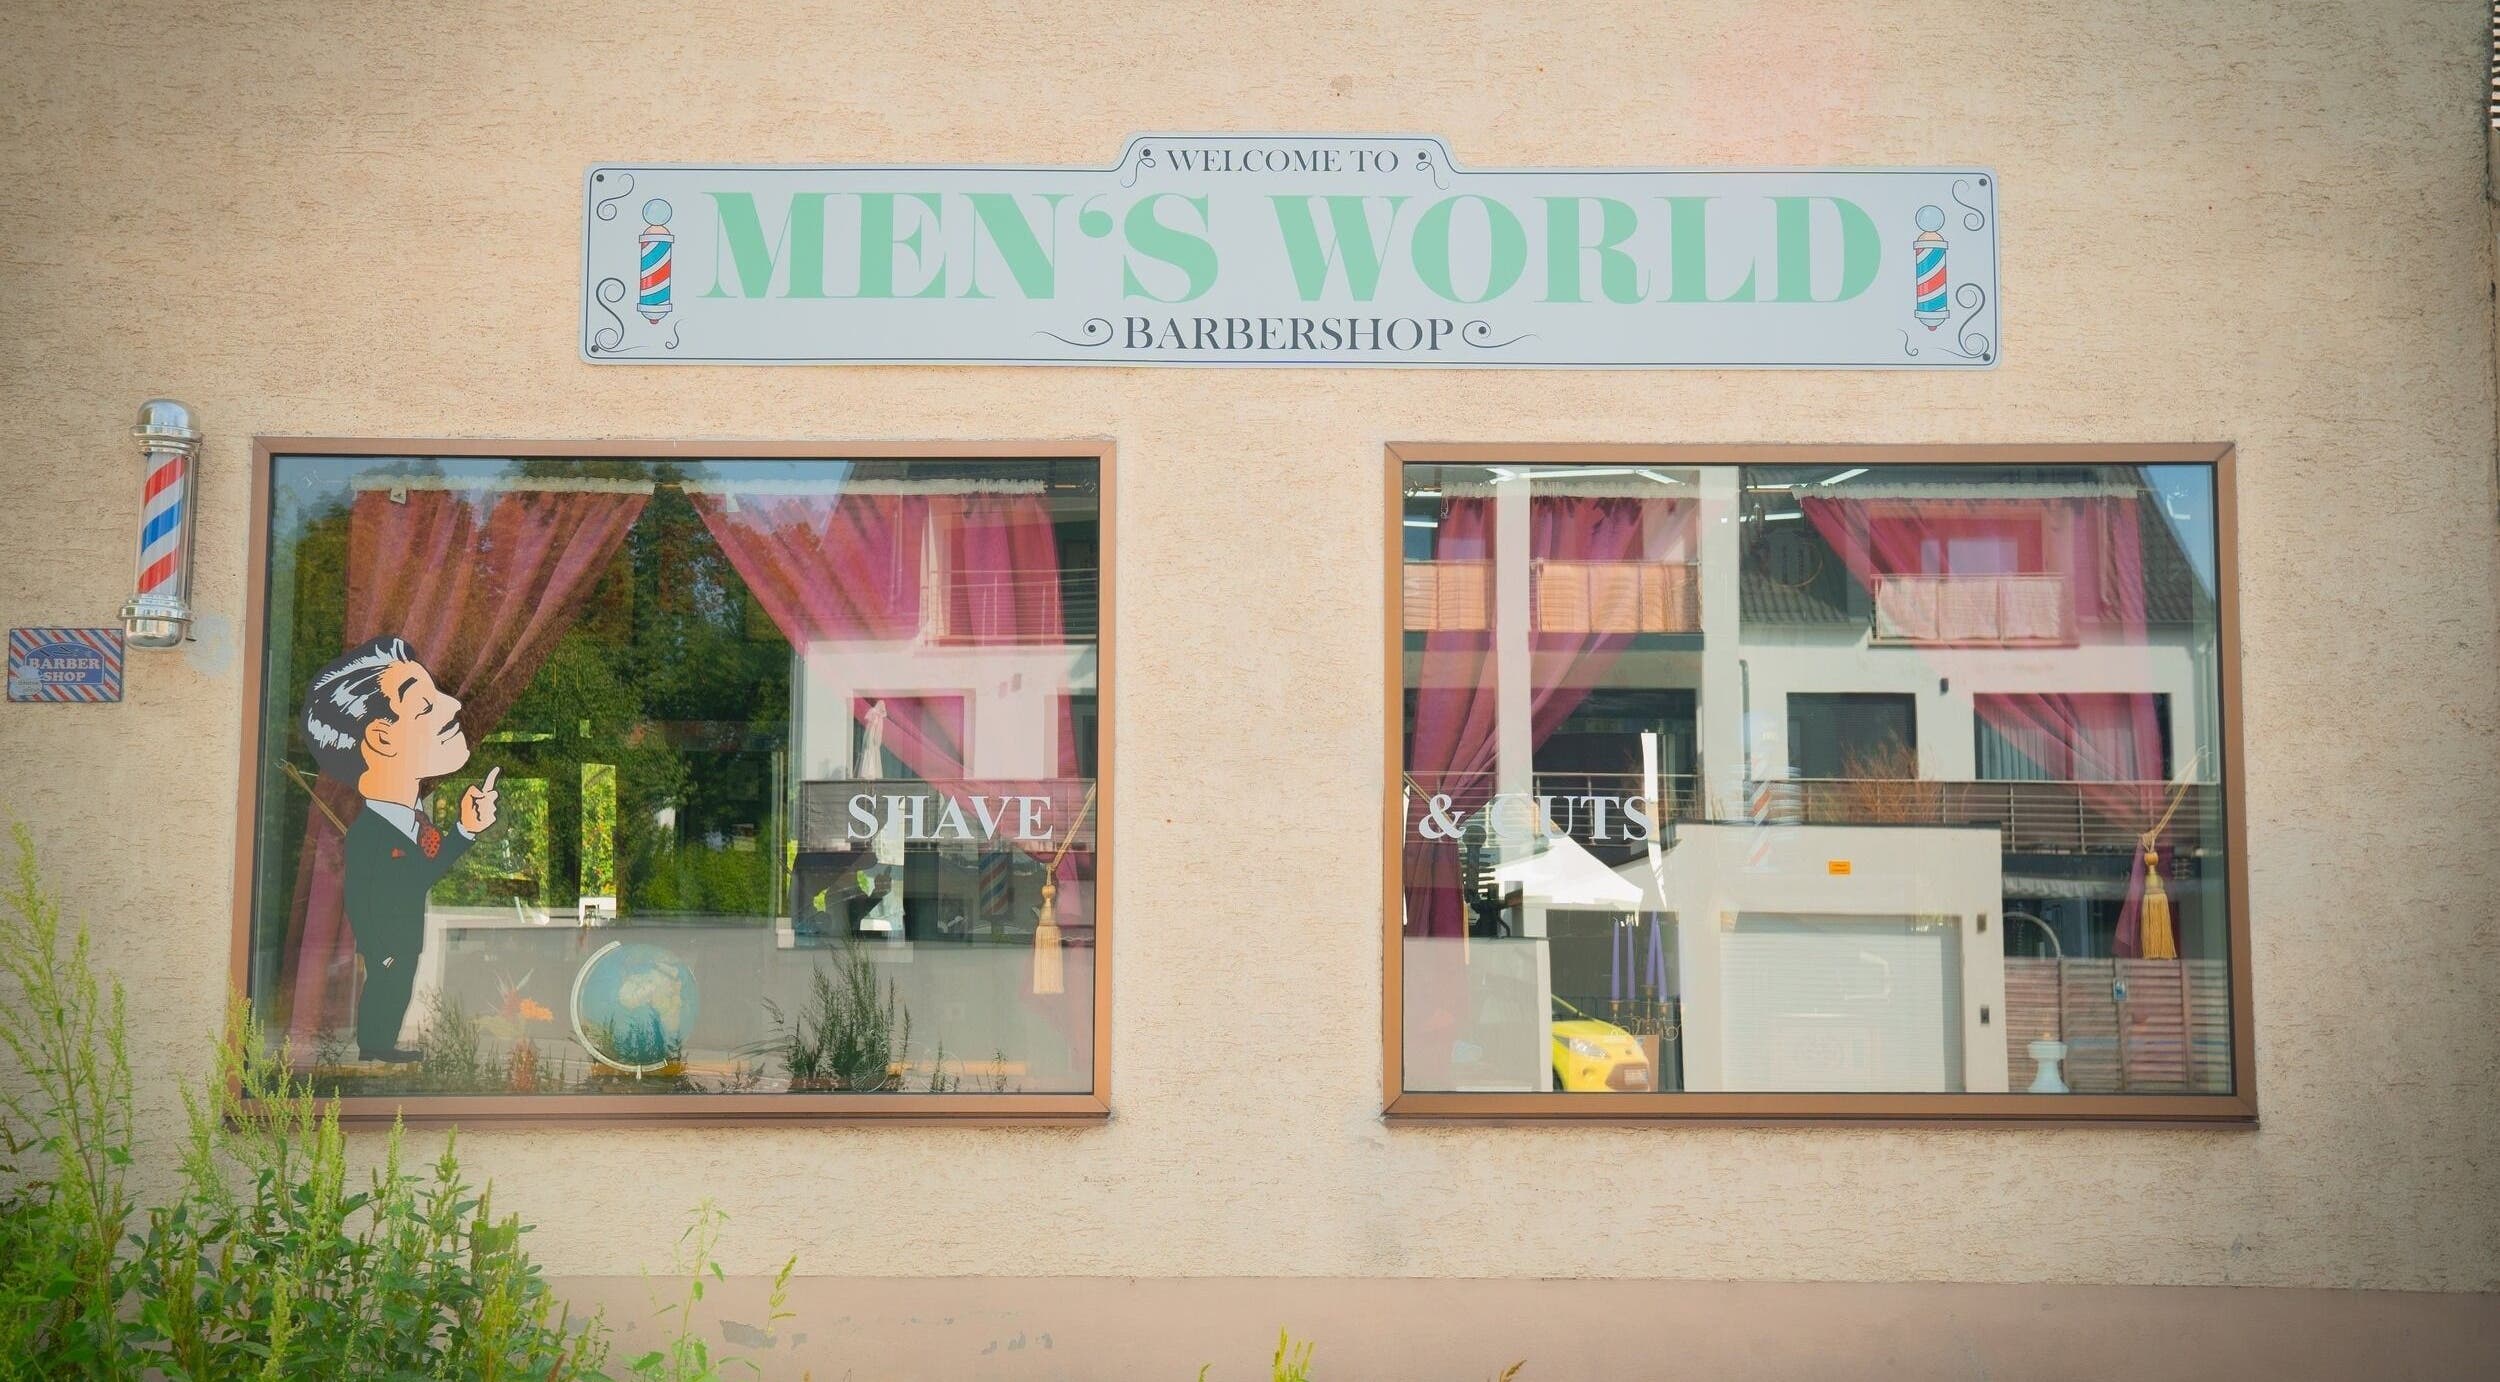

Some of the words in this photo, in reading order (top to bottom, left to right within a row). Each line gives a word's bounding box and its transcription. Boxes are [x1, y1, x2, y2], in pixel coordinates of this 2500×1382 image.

[1165, 149, 1342, 172] WELCOME
[1350, 149, 1399, 173] TO
[1263, 194, 1882, 304] WORLD
[1123, 316, 1454, 351] BARBERSHOP
[30, 658, 100, 669] BARBER
[43, 671, 85, 681] SHOP
[847, 793, 1054, 840] SHAVE
[1418, 793, 1466, 839] &
